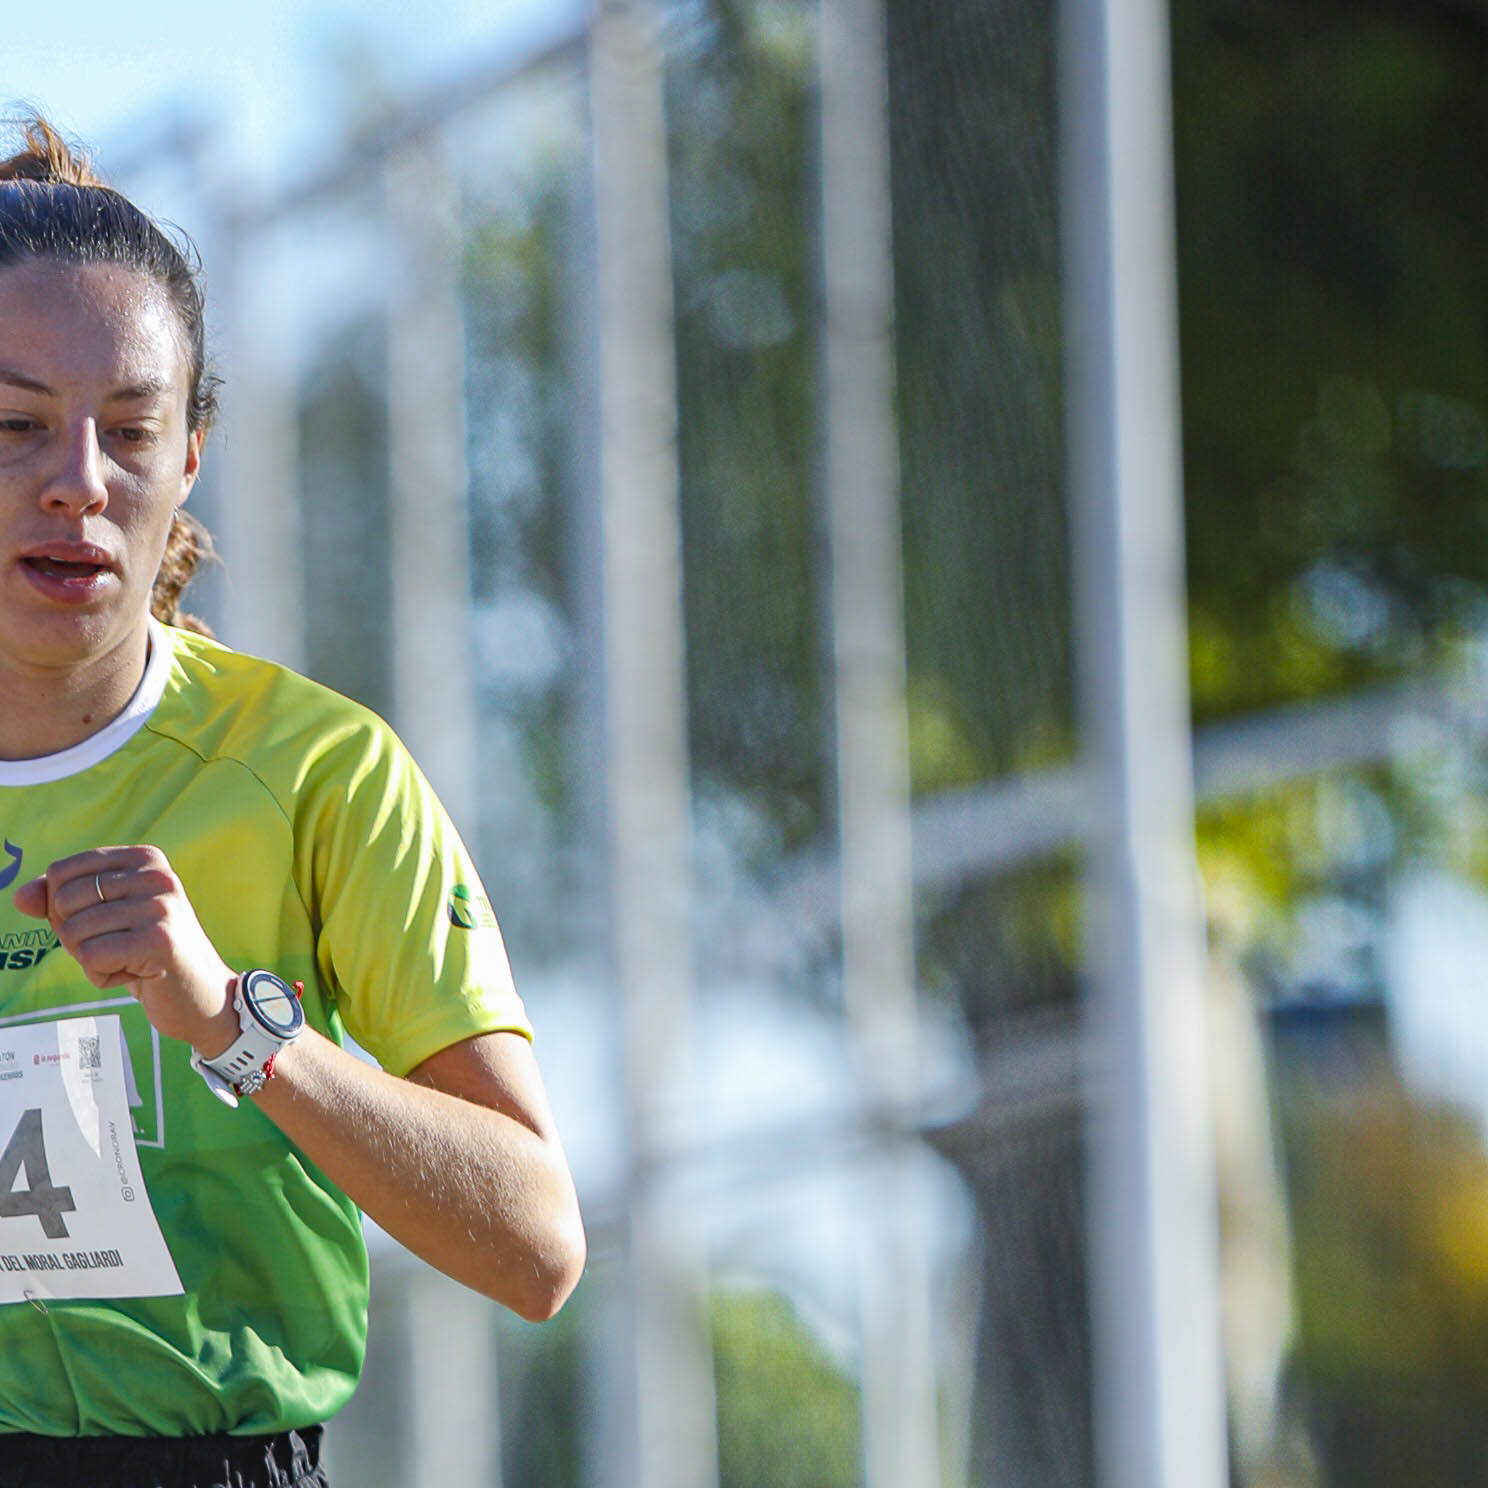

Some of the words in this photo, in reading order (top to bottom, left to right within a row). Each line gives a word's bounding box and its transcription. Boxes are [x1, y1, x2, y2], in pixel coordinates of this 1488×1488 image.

[1, 1254, 26, 1271] DEL
[22, 1253, 65, 1270] MORAL
[62, 1249, 124, 1270] GAGLIARDI
